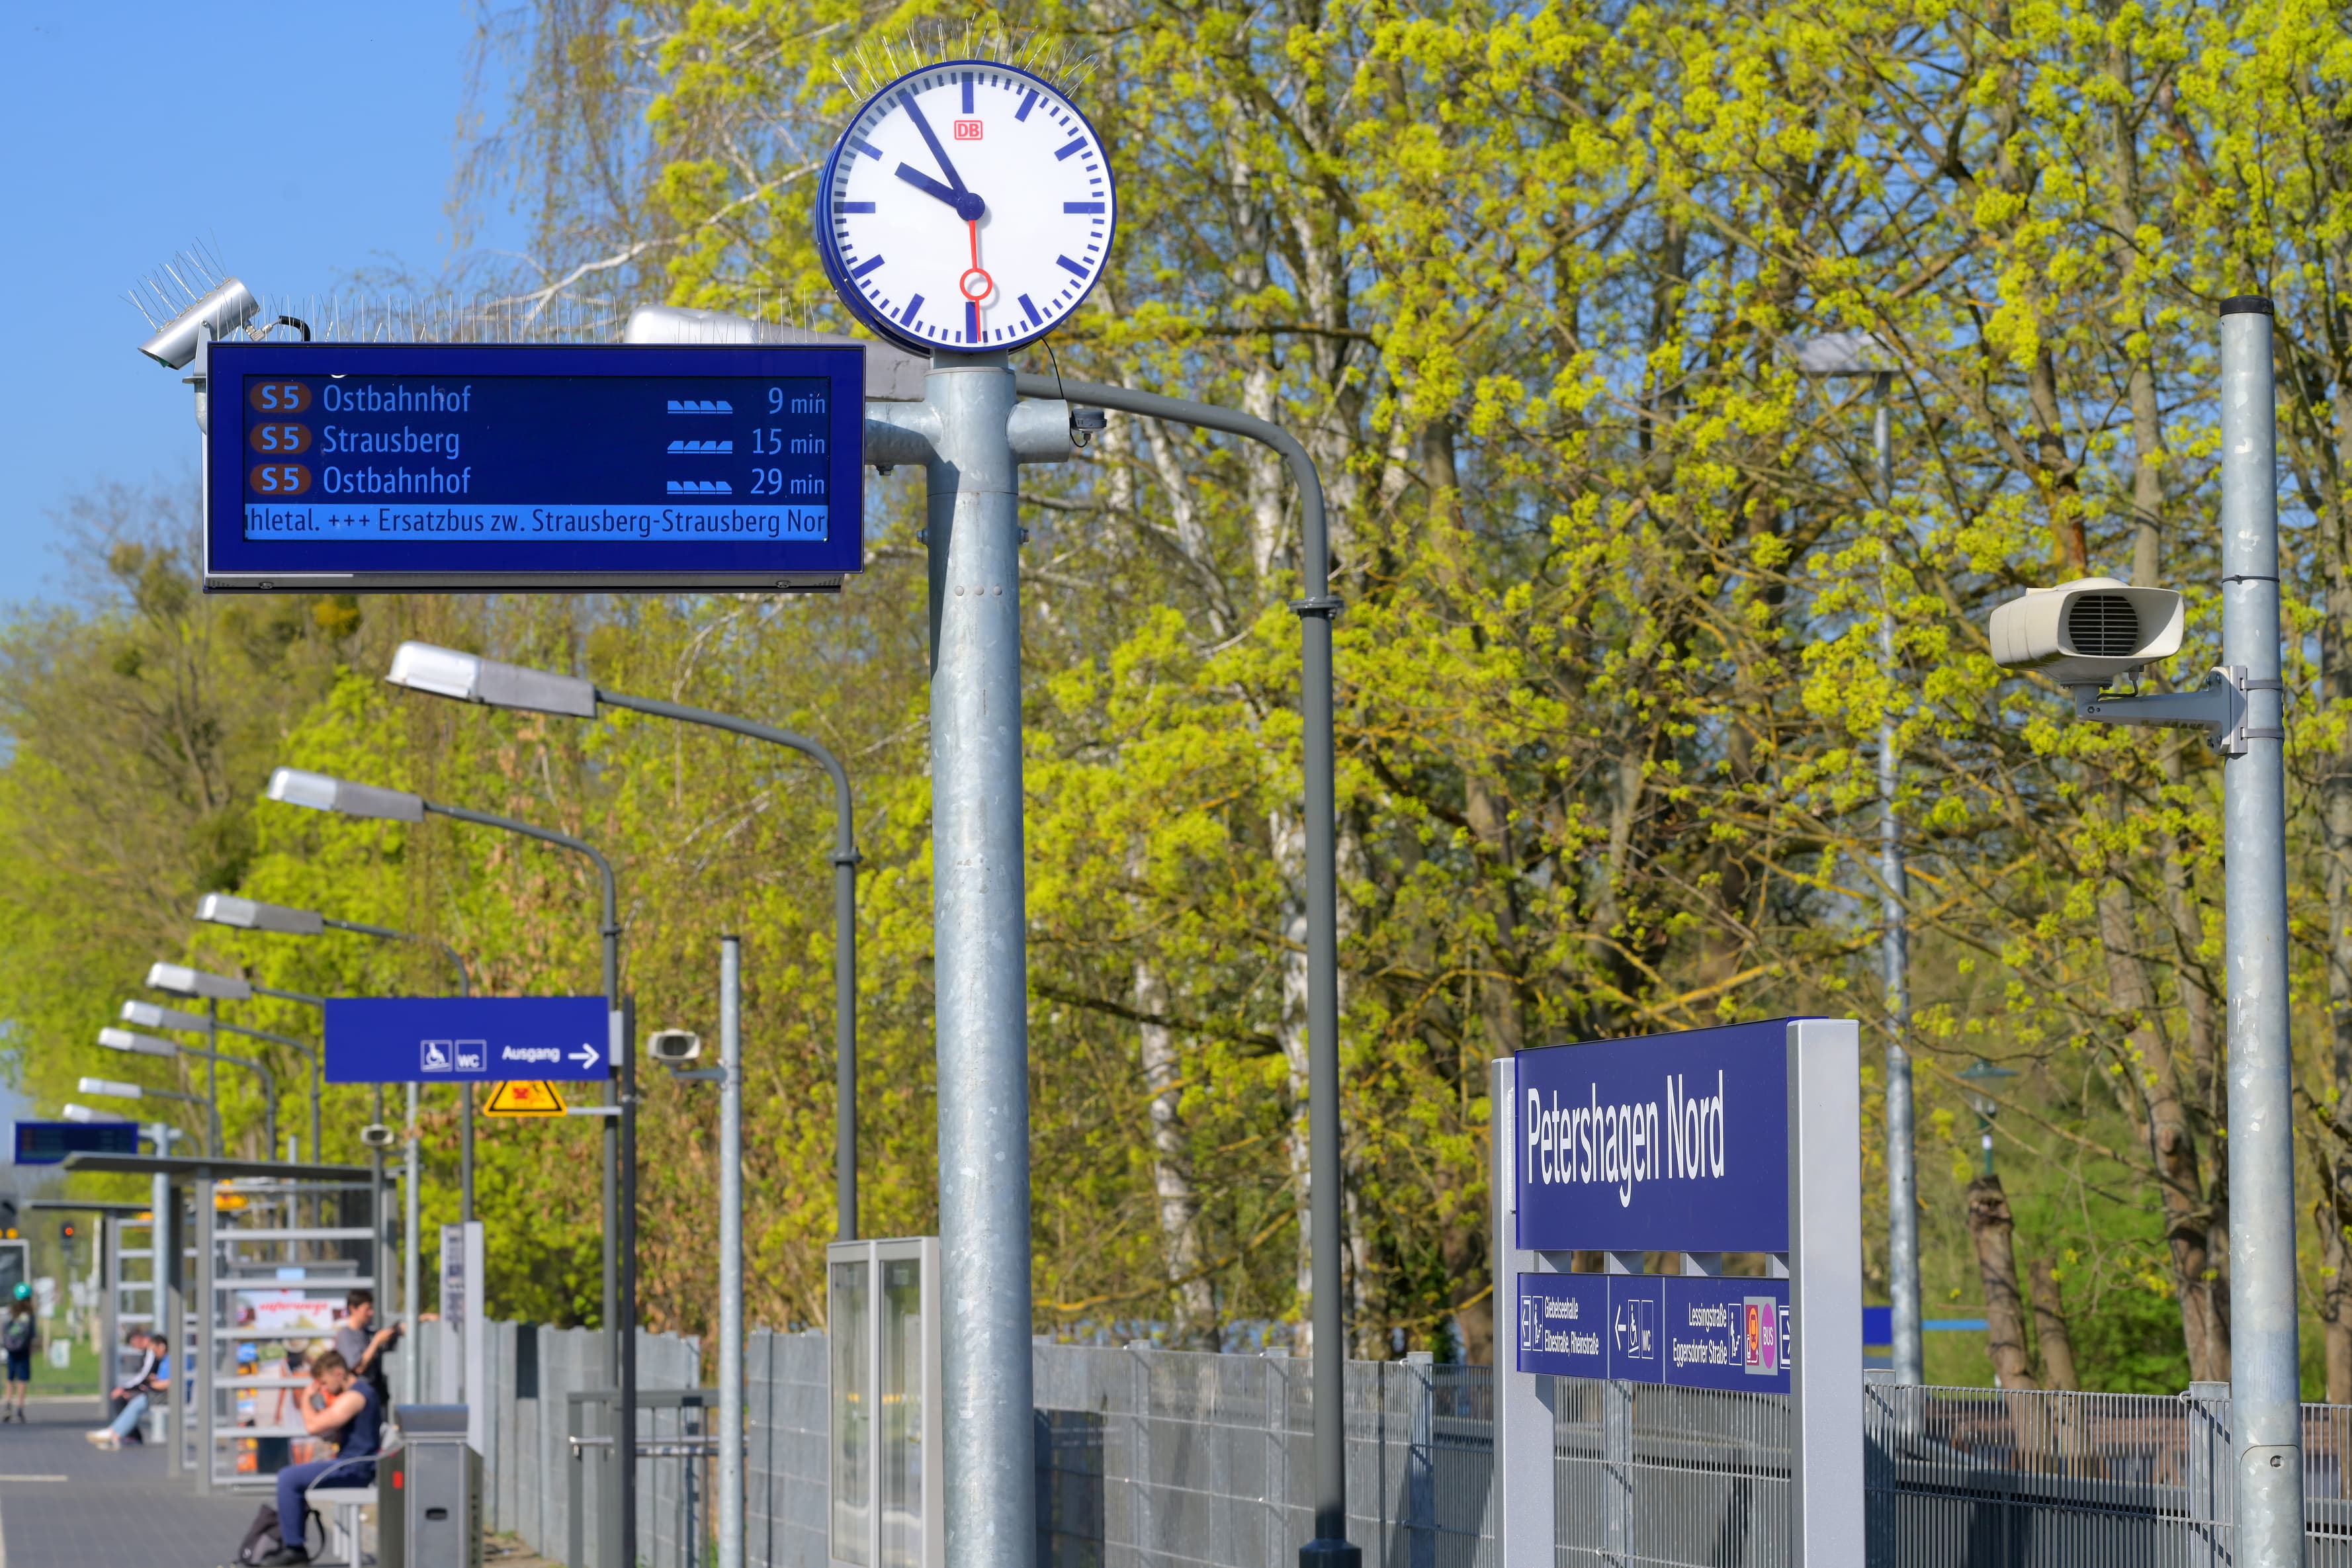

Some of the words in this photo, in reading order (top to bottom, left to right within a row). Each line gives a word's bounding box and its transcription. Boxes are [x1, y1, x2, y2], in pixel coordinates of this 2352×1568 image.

[957, 123, 980, 137] DB
[324, 384, 472, 412] Ostbahnhof
[768, 387, 783, 414] 9
[791, 393, 826, 414] min
[323, 425, 460, 460] Strausberg
[752, 428, 782, 455] 15
[791, 433, 825, 454] min
[324, 466, 472, 494] Ostbahnhof
[750, 468, 783, 495] 29
[791, 474, 824, 494] min
[378, 507, 484, 532] Ersatzbus
[490, 514, 525, 532] zw.
[531, 507, 780, 539] Strausberg-Strausberg
[457, 1053, 480, 1068] WC
[501, 1045, 561, 1063] Ausgang
[1528, 1082, 1660, 1208] Petershagen
[1667, 1069, 1725, 1180] Nord
[1545, 1295, 1579, 1320] Giebelseehalle
[1688, 1302, 1727, 1332] Lessingstraße
[1545, 1329, 1570, 1357] Elbestraße,
[1571, 1331, 1600, 1356] Rheinstraße
[1642, 1330, 1651, 1352] WC
[1763, 1326, 1774, 1346] BUS
[1673, 1337, 1708, 1368] Eggersdorfer
[1709, 1338, 1727, 1365] Straße
